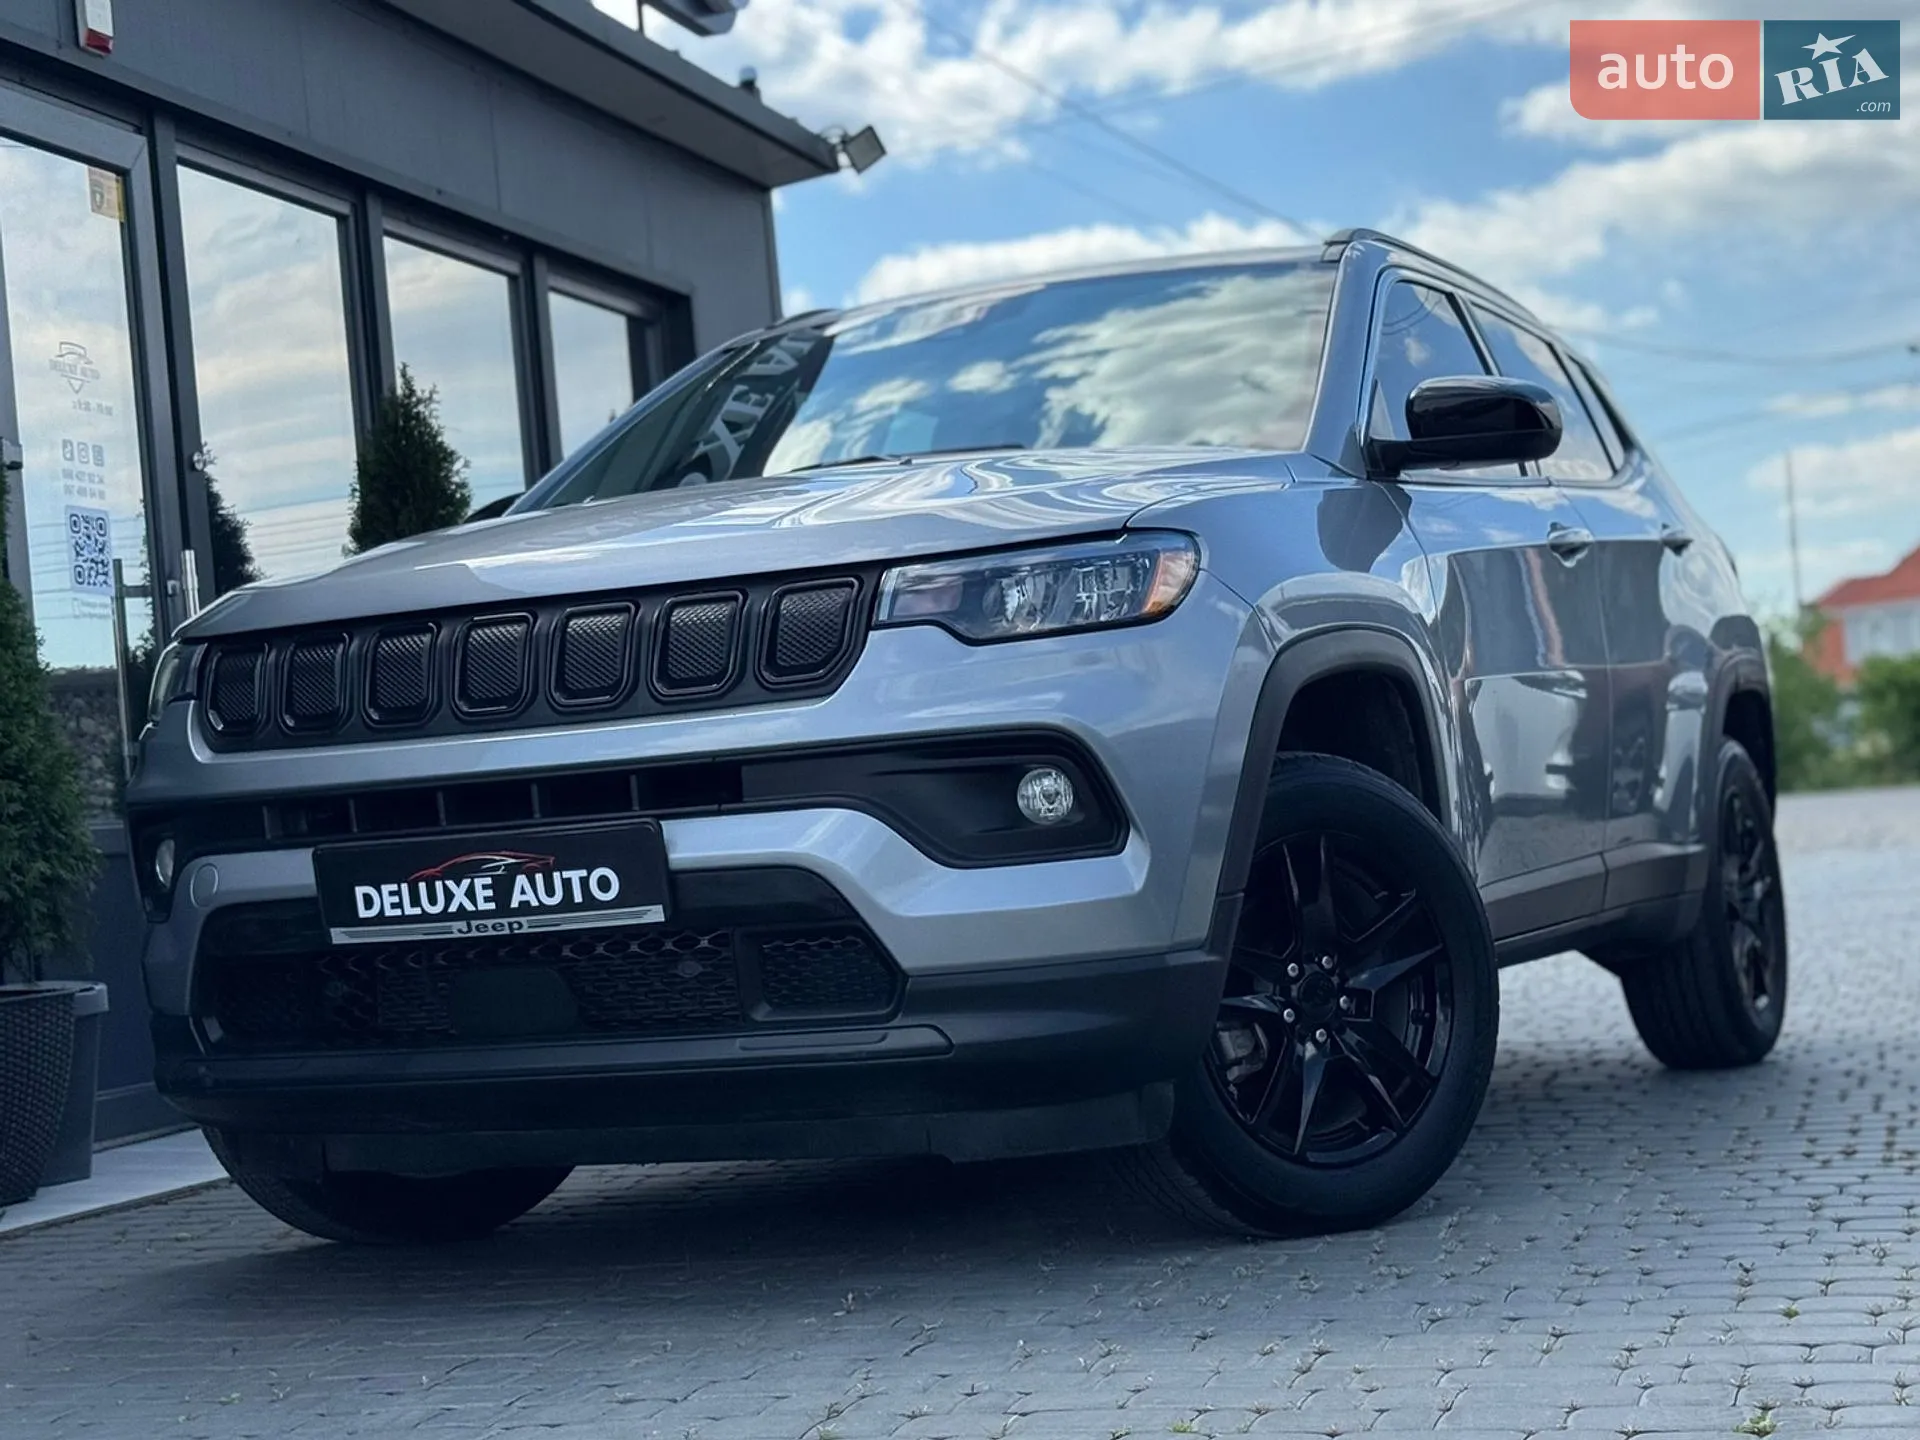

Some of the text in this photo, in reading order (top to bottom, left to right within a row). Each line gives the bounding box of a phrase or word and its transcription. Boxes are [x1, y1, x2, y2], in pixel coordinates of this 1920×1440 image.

[354, 867, 620, 918] DELUXE AUTO
[457, 920, 523, 934] Jeep
